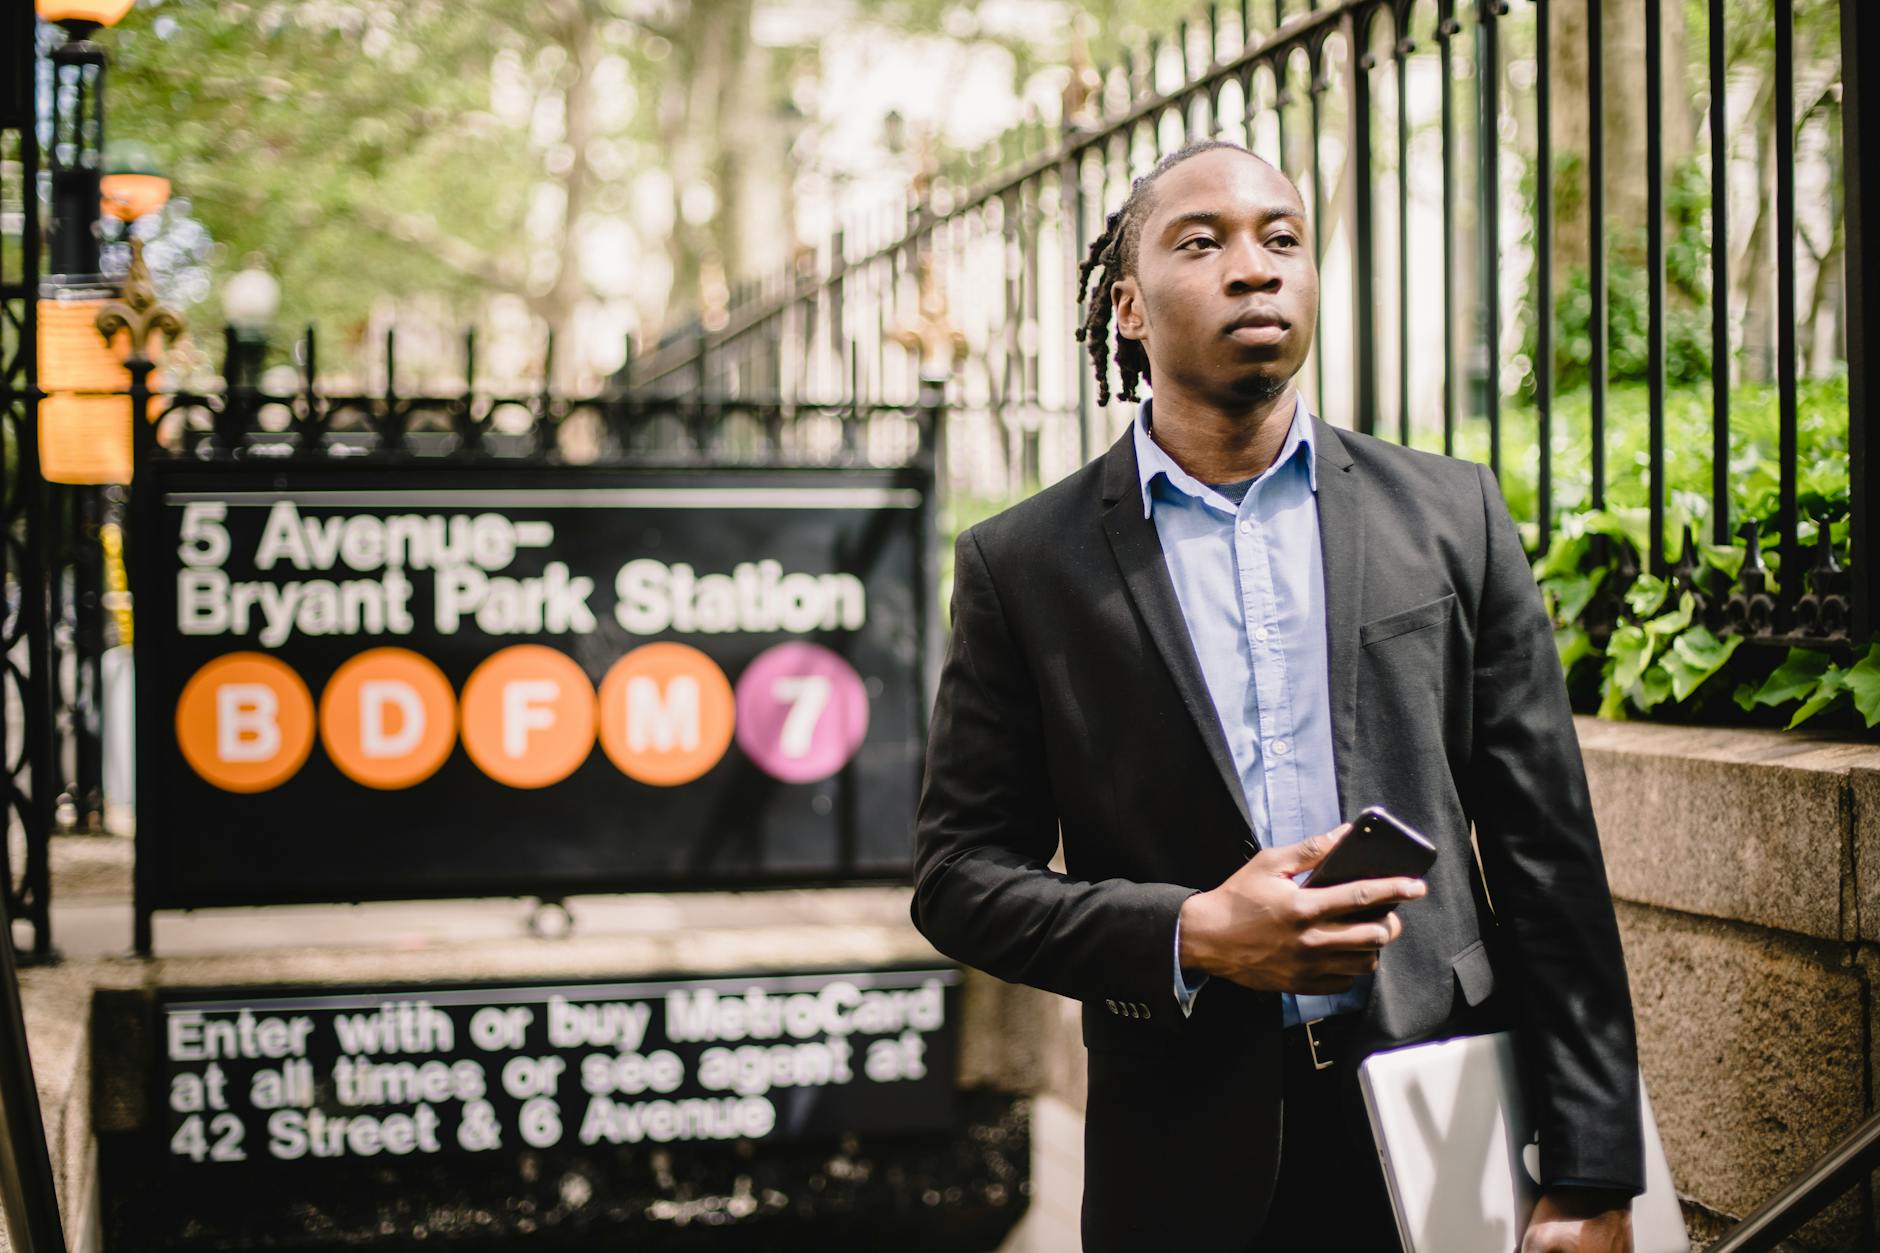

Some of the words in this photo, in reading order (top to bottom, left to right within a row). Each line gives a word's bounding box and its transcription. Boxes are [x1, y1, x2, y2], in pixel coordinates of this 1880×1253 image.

[177, 500, 231, 568] 5
[177, 567, 413, 647] Bryant
[434, 562, 597, 635] Park
[616, 559, 865, 632] Station
[217, 684, 281, 762] B
[359, 680, 425, 757] D
[504, 680, 560, 757] F
[625, 676, 700, 752] M
[772, 676, 832, 758] 7
[168, 1009, 314, 1060] Enter
[334, 1001, 454, 1054] with
[470, 1007, 534, 1051] or
[547, 995, 651, 1052] buy
[665, 979, 944, 1042] MetroCard
[170, 1062, 227, 1112] at
[250, 1058, 314, 1109] all
[333, 1055, 487, 1105] times
[502, 1055, 566, 1100] or
[581, 1049, 685, 1095] see
[698, 1036, 853, 1096] agent
[865, 1030, 926, 1082] at
[170, 1114, 246, 1162] 42
[268, 1103, 441, 1160] Street
[457, 1099, 502, 1152] &
[519, 1097, 562, 1148] 6
[580, 1096, 776, 1145] Avenue
